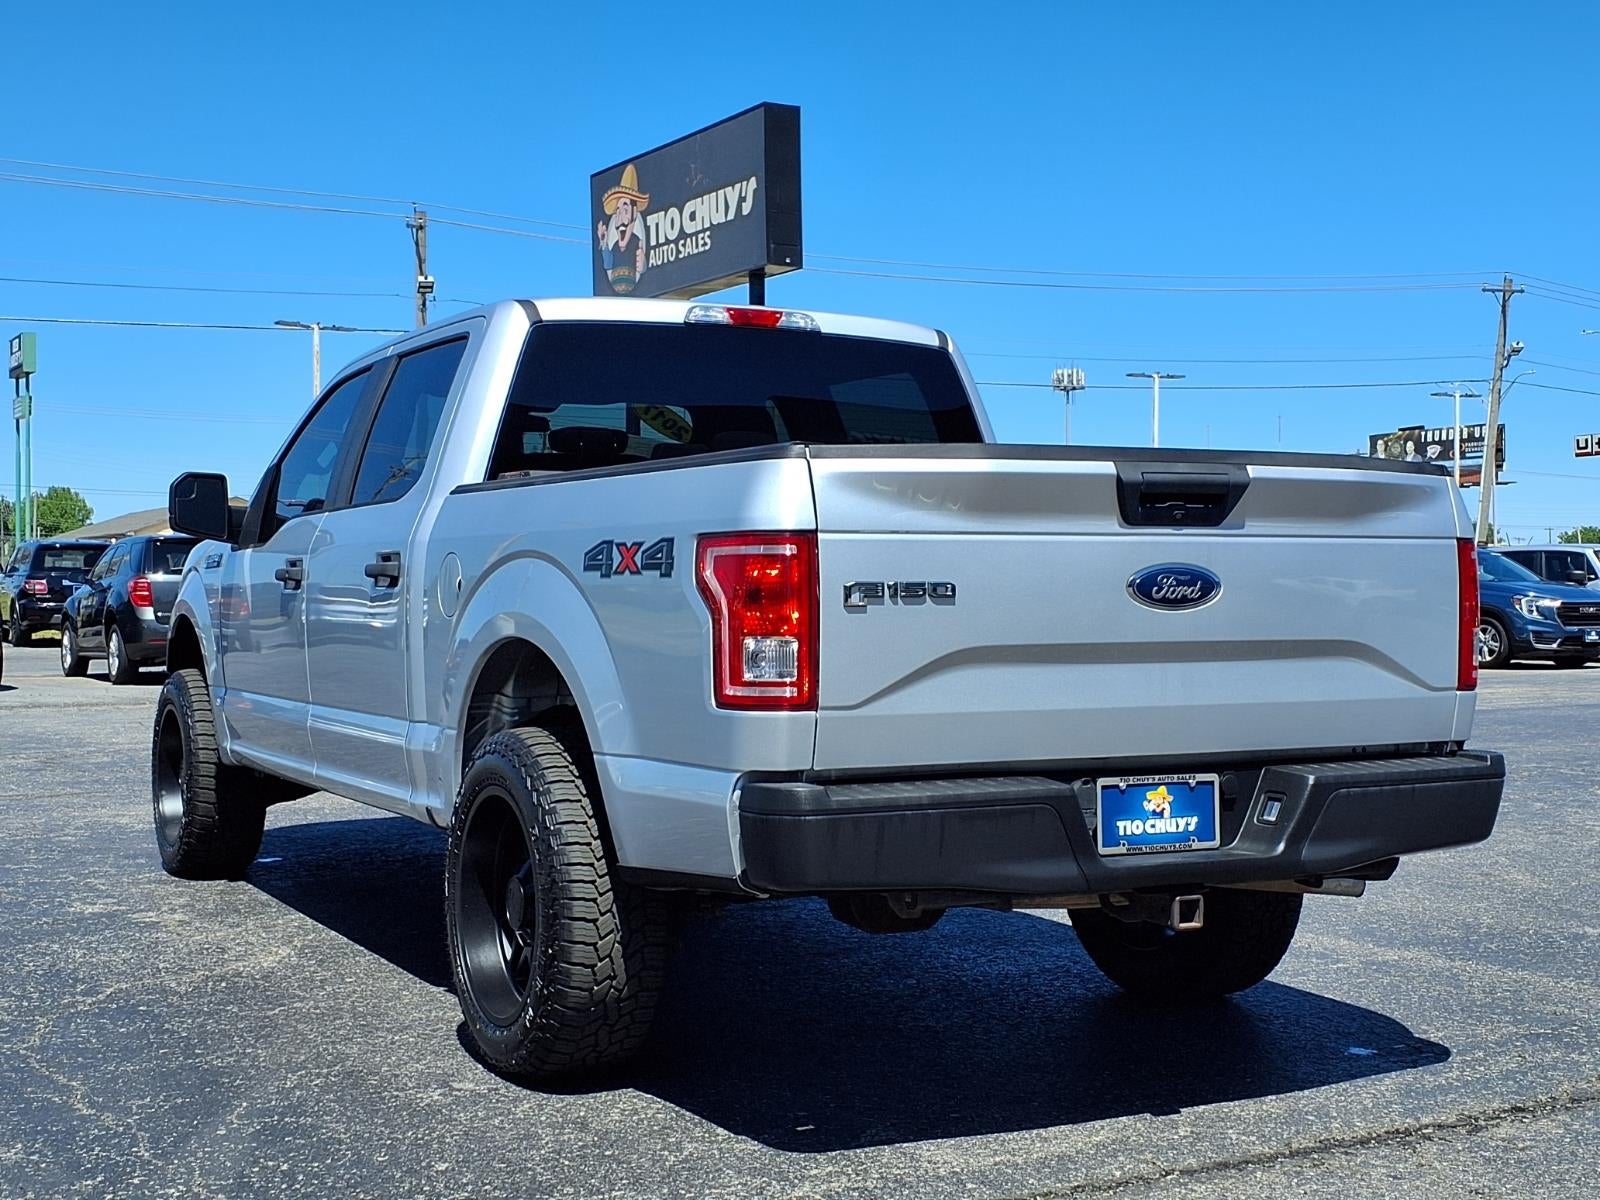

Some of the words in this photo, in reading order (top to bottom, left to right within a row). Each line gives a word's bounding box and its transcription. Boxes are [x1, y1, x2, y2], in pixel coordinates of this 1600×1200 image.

[646, 206, 681, 246] TIO
[682, 176, 758, 235] CHUY'S
[648, 243, 677, 268] AUTO
[678, 231, 711, 259] SALES
[1151, 573, 1202, 600] Ford
[1116, 819, 1144, 836] TIO
[1144, 816, 1199, 834] CHUY'S
[1126, 844, 1193, 853] WWW.TIOCHUYS.COM
